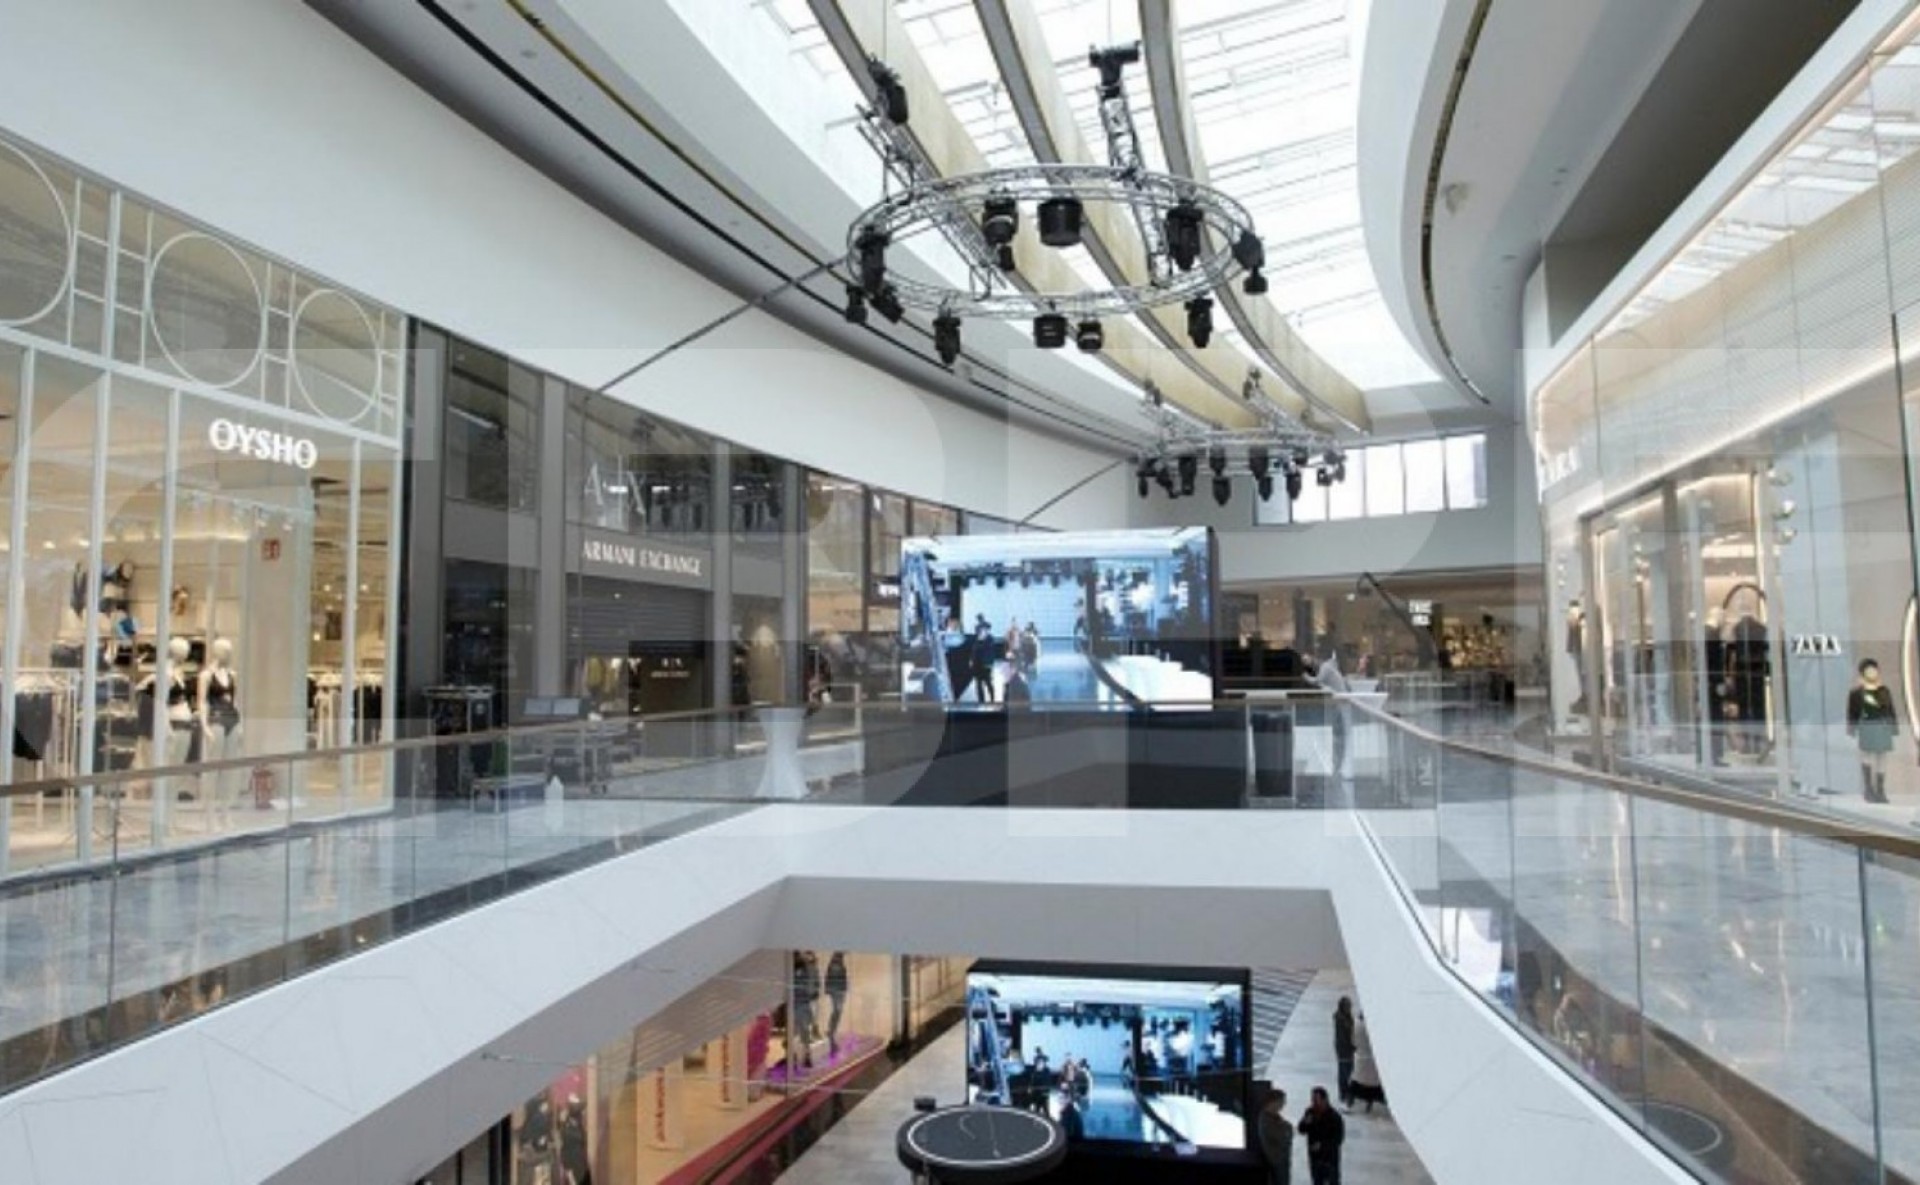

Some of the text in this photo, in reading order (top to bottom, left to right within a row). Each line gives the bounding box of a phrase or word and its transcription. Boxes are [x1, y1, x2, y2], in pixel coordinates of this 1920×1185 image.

[208, 418, 318, 469] OYSHO
[583, 540, 702, 577] ARMANI EXCHANGE
